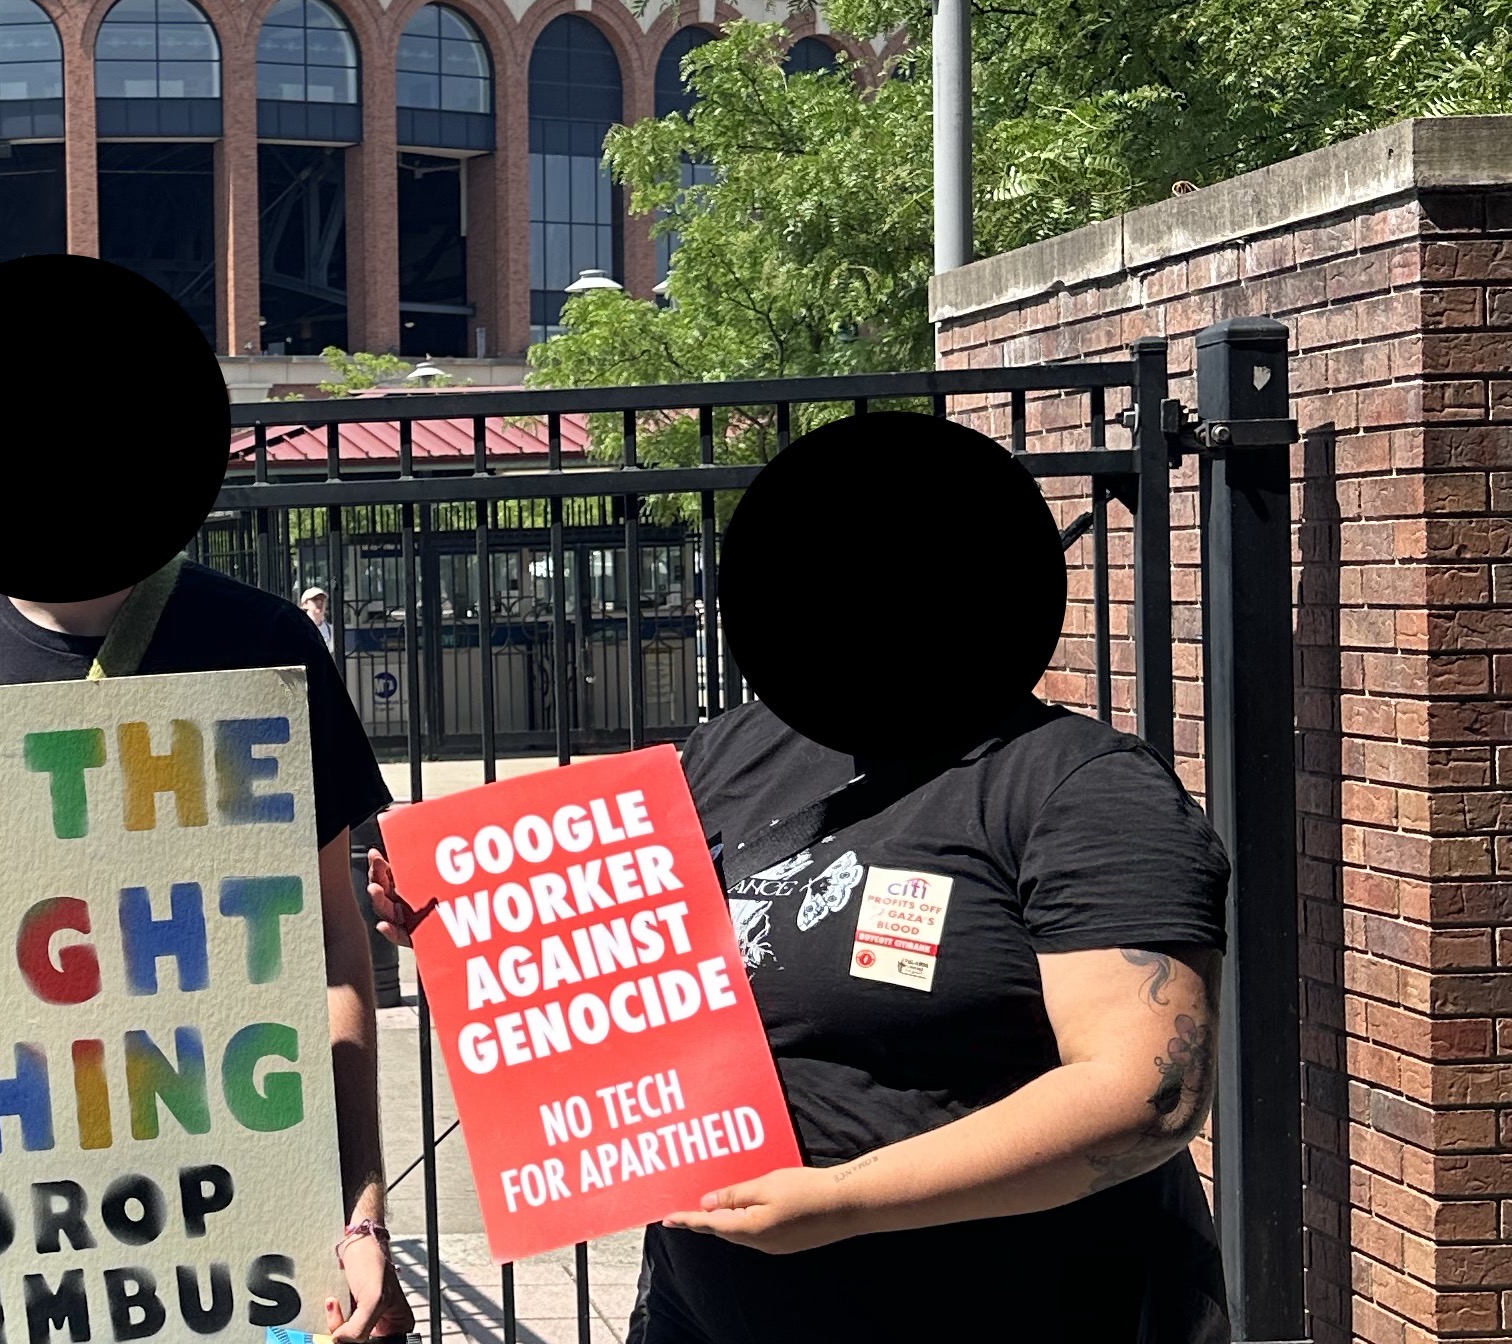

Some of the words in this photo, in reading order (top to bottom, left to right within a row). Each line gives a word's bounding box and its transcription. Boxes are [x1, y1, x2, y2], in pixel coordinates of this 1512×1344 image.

[23, 716, 296, 840] THE
[434, 789, 654, 886] GOOGLE
[435, 844, 684, 949] WORKER
[867, 894, 916, 910] PROFITS
[919, 903, 943, 915] OFF
[877, 920, 920, 935] BLOOD
[887, 879, 927, 900] citi
[466, 902, 692, 1011] AGAINST
[457, 956, 738, 1075] GENOCIDE
[538, 1093, 593, 1147] NO
[596, 1068, 686, 1131] TECH
[500, 1148, 570, 1213] FOR
[579, 1105, 766, 1193] APARTHEID
